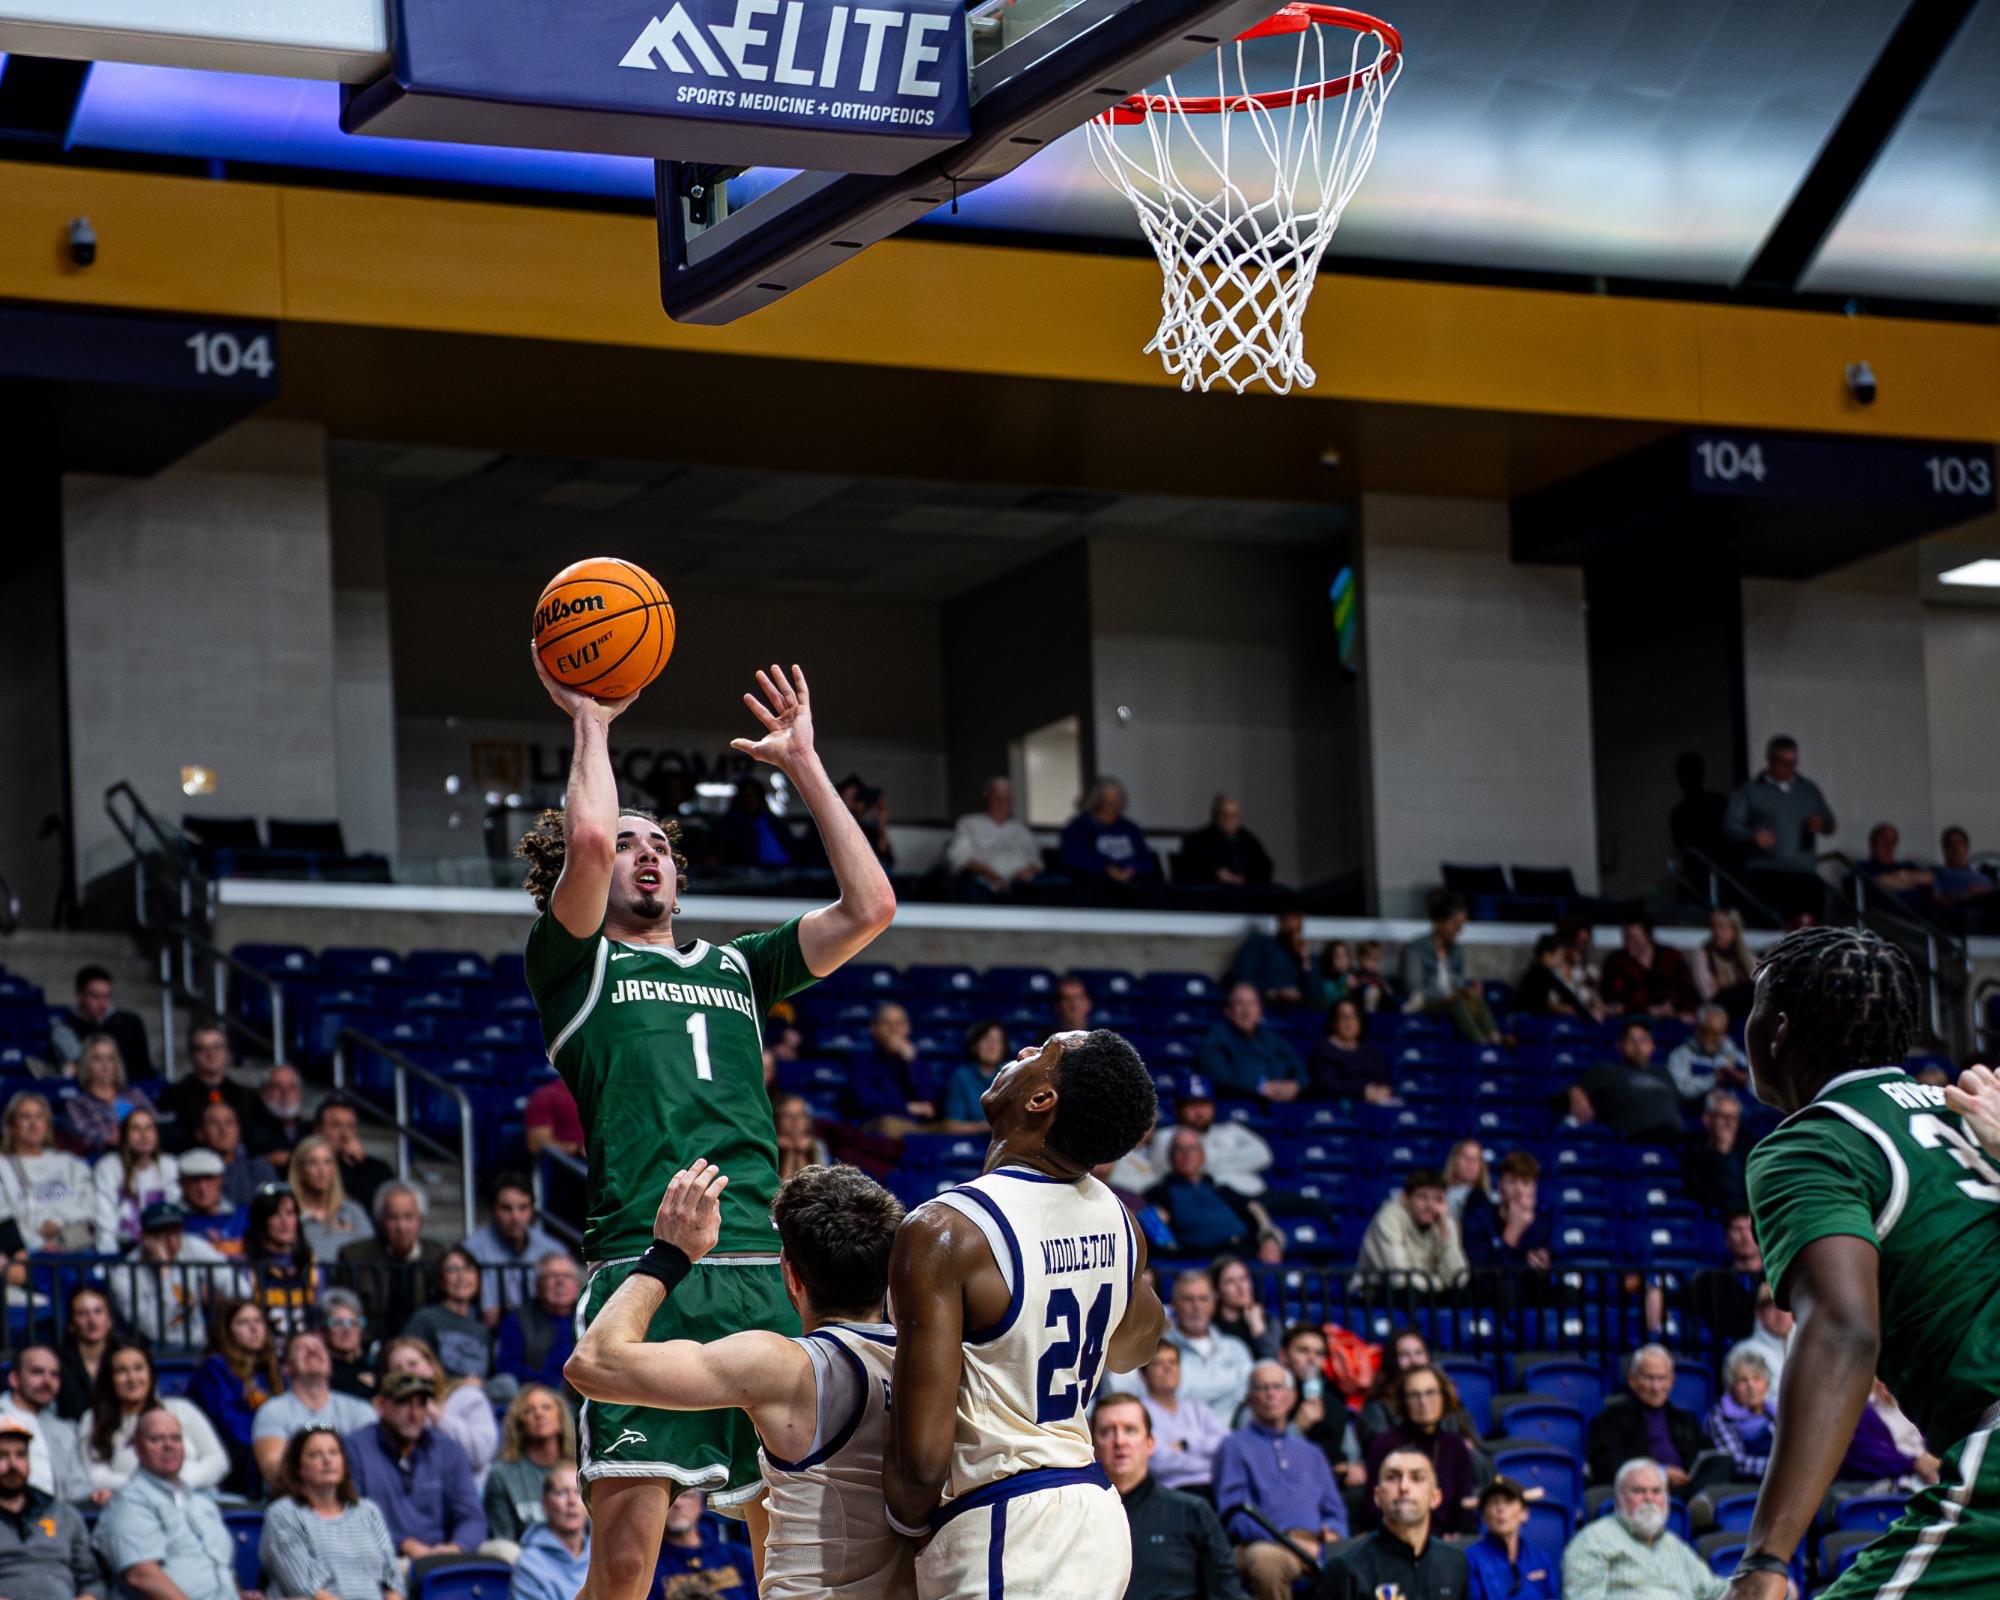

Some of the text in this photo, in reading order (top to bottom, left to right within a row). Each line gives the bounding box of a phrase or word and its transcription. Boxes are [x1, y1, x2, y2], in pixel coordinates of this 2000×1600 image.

[708, 0, 951, 97] ELITE
[676, 86, 736, 108] SPORTS
[739, 92, 816, 115] MEDICINE
[831, 102, 935, 126] ORTHOPEDICS
[185, 331, 275, 379] 104
[1696, 440, 1768, 482] 104
[1925, 456, 1993, 495] 103
[534, 593, 606, 638] Wilson
[612, 979, 753, 1021] JACKSONVILLE
[685, 1011, 714, 1082] 1
[1909, 1112, 2000, 1204] 3
[1040, 1232, 1116, 1275] MIDDLETON
[1036, 1282, 1113, 1425] 24
